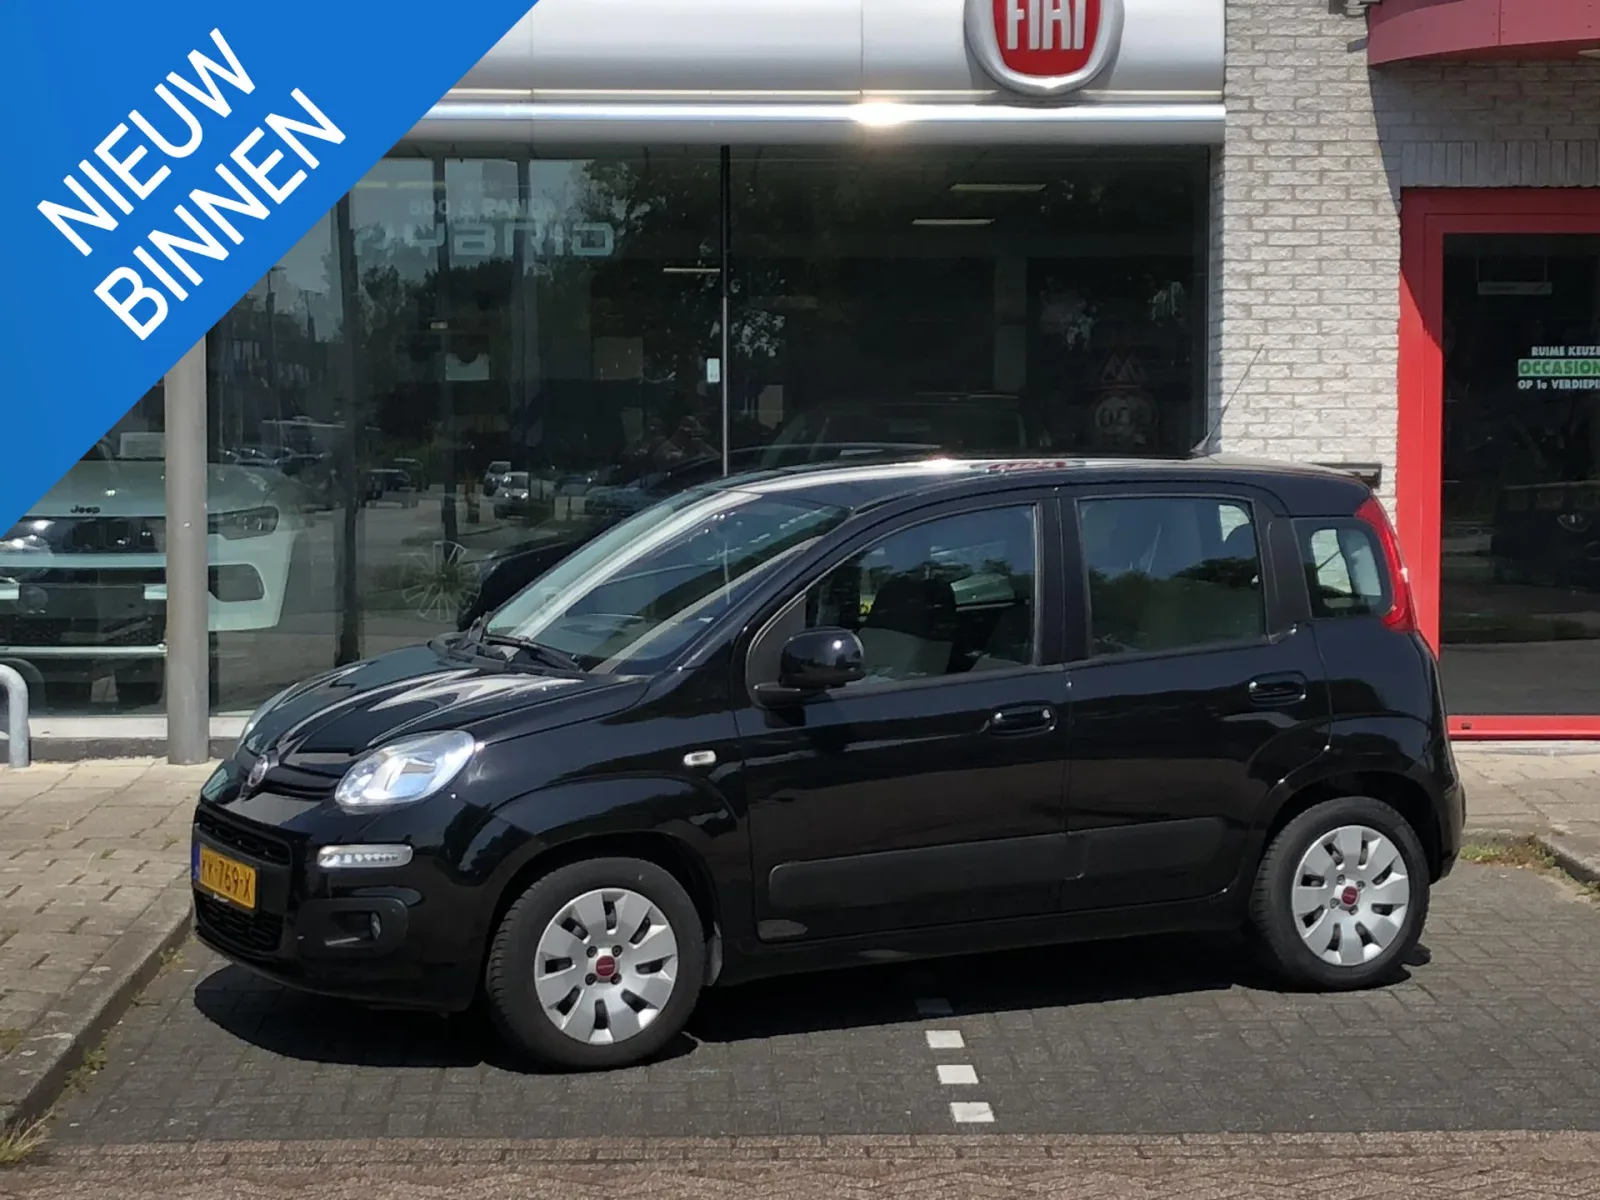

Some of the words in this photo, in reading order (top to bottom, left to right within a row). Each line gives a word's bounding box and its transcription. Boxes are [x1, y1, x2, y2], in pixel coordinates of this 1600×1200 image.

[1531, 345, 1565, 356] RUIME
[1517, 379, 1533, 390] OP
[1551, 379, 1600, 390] VERDIEPI
[70, 504, 101, 515] Jeep
